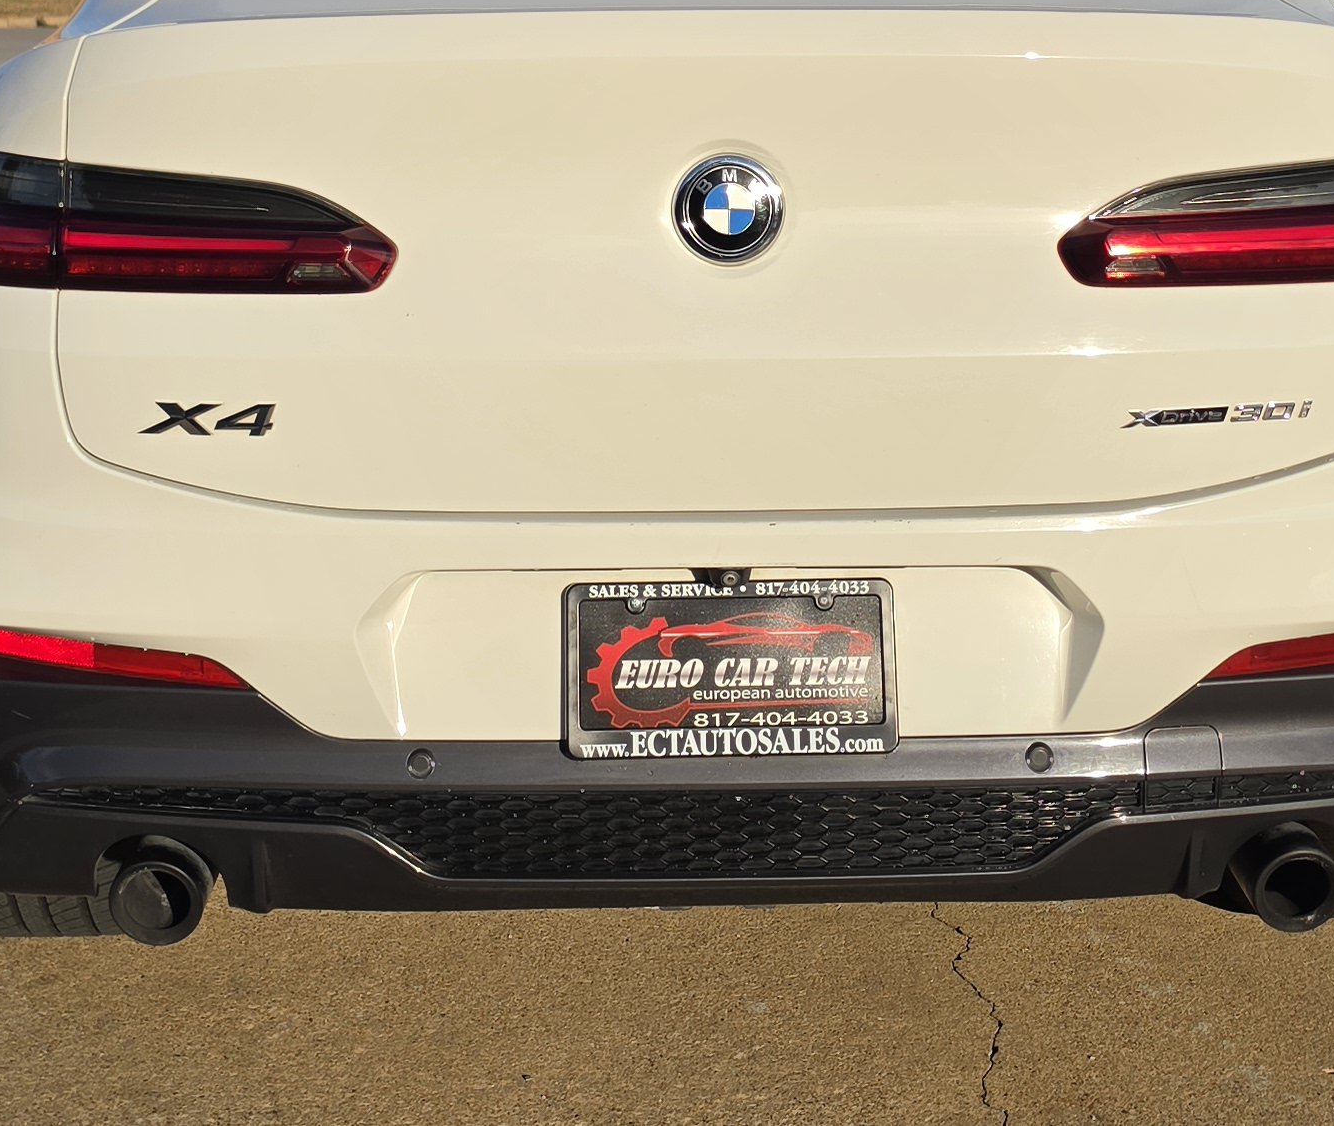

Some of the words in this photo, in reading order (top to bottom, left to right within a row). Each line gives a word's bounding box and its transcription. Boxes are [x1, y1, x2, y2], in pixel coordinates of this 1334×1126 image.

[137, 401, 276, 436] X4
[588, 584, 638, 598] SALES
[643, 583, 661, 598] &
[661, 583, 734, 597] SERVICE
[755, 580, 870, 596] 817-404-4033
[615, 658, 704, 690] EURO
[714, 658, 780, 688] CAR
[789, 656, 872, 686] TECH
[693, 687, 771, 702] european
[774, 684, 868, 700] automotive
[693, 710, 869, 727] 817-404-4033
[579, 727, 885, 759] www.ECTAUTOSALES.com
